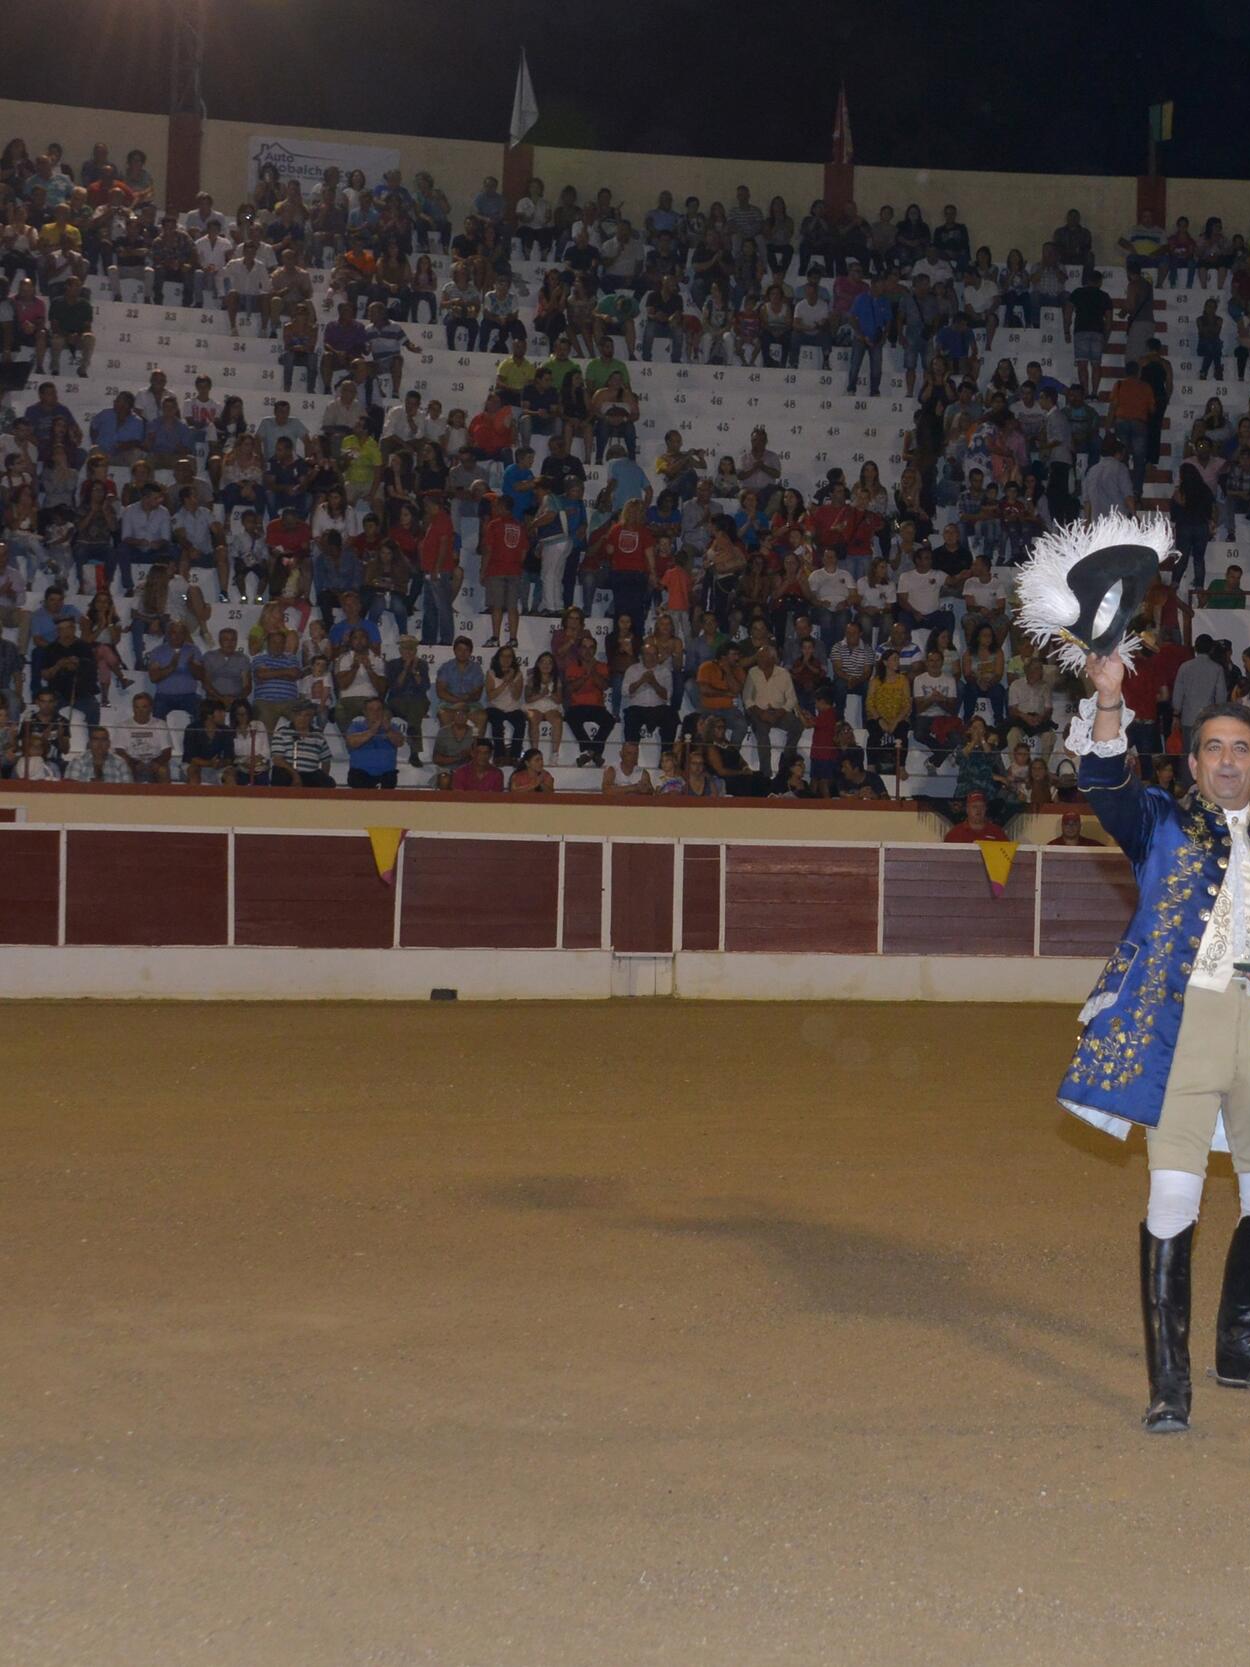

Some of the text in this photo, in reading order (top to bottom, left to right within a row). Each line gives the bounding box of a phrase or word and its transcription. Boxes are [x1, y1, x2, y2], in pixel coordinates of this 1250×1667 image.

[264, 152, 294, 163] Auto
[1177, 295, 1187, 303] 63
[126, 309, 138, 318] 32
[201, 314, 213, 324] 34
[120, 333, 130, 343] 31
[422, 331, 432, 339] 40
[1009, 334, 1020, 342] 58
[158, 337, 170, 346] 32
[196, 339, 208, 348] 33
[1179, 339, 1189, 347] 61
[234, 343, 245, 352] 34
[421, 355, 433, 364] 39
[458, 357, 470, 366] 40
[1041, 358, 1052, 366] 58
[107, 360, 120, 368] 30
[1181, 362, 1192, 370] 60
[184, 365, 197, 374] 32
[223, 368, 235, 376] 33
[641, 368, 652, 376] 45
[262, 370, 274, 380] 34
[713, 372, 724, 380] 47
[749, 374, 760, 382] 48
[784, 375, 796, 383] 49
[820, 376, 832, 385] 50
[890, 379, 902, 387] 52
[66, 384, 78, 393] 28
[452, 383, 464, 391] 39
[1182, 386, 1192, 394] 58
[1216, 387, 1228, 396] 59
[674, 395, 686, 403] 45
[711, 396, 722, 405] 46
[748, 398, 758, 406] 47
[302, 401, 314, 409] 34
[784, 400, 796, 408] 48
[821, 401, 831, 409] 49
[855, 401, 866, 410] 50
[892, 403, 902, 412] 51
[1184, 410, 1194, 419] 57
[717, 423, 729, 431] 45
[791, 426, 802, 434] 47
[828, 427, 840, 436] 48
[779, 451, 790, 460] 46
[816, 453, 827, 461] 47
[852, 453, 864, 462] 48
[890, 455, 901, 463] 49
[1227, 549, 1239, 558] 50
[229, 610, 242, 619] 25
[460, 621, 473, 630] 30
